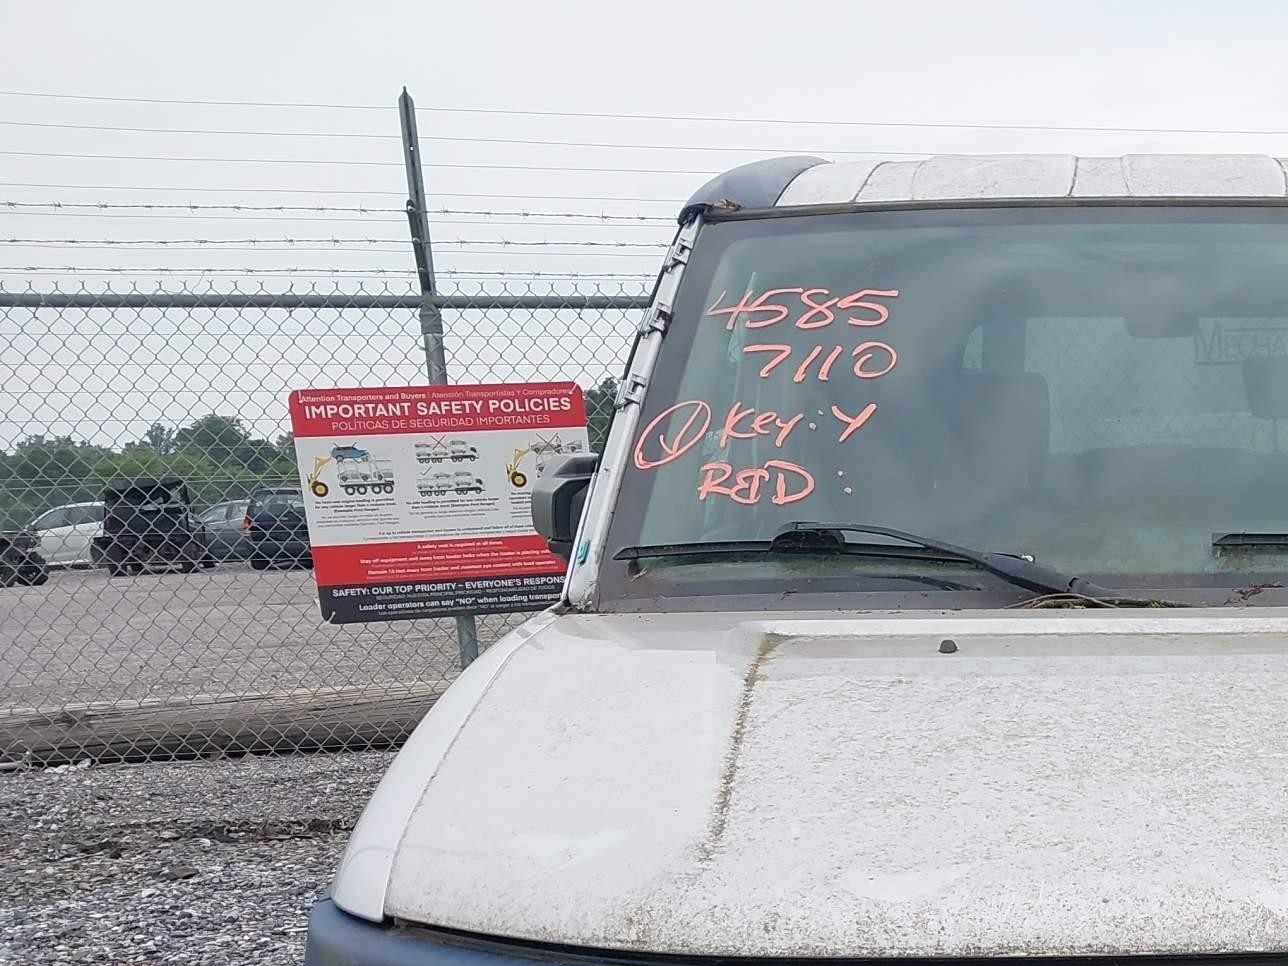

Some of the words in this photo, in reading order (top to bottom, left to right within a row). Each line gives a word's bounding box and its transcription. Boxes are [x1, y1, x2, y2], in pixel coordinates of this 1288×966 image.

[705, 287, 899, 330] 4585
[742, 341, 897, 383] 7110
[301, 394, 335, 402] Attention
[337, 394, 383, 403] Transporters
[400, 392, 426, 401] Buyers
[304, 402, 411, 419] IMPORTANT
[416, 399, 483, 415] SAFETY
[489, 397, 571, 412] POLICIES
[331, 418, 389, 430] POLÍTICAS
[392, 420, 407, 428] DE
[409, 416, 474, 428] SEGURIDAD
[476, 414, 550, 426] IMPORTANTES
[831, 403, 877, 443] Y
[332, 587, 370, 598] SAFETY:
[372, 586, 392, 595] OUR
[394, 585, 413, 593] TOP
[415, 582, 456, 592] PRIORITY
[465, 579, 522, 589] EVERYONE'S
[524, 576, 566, 585] RESPONS
[388, 602, 424, 610] operators
[500, 594, 528, 603] loading
